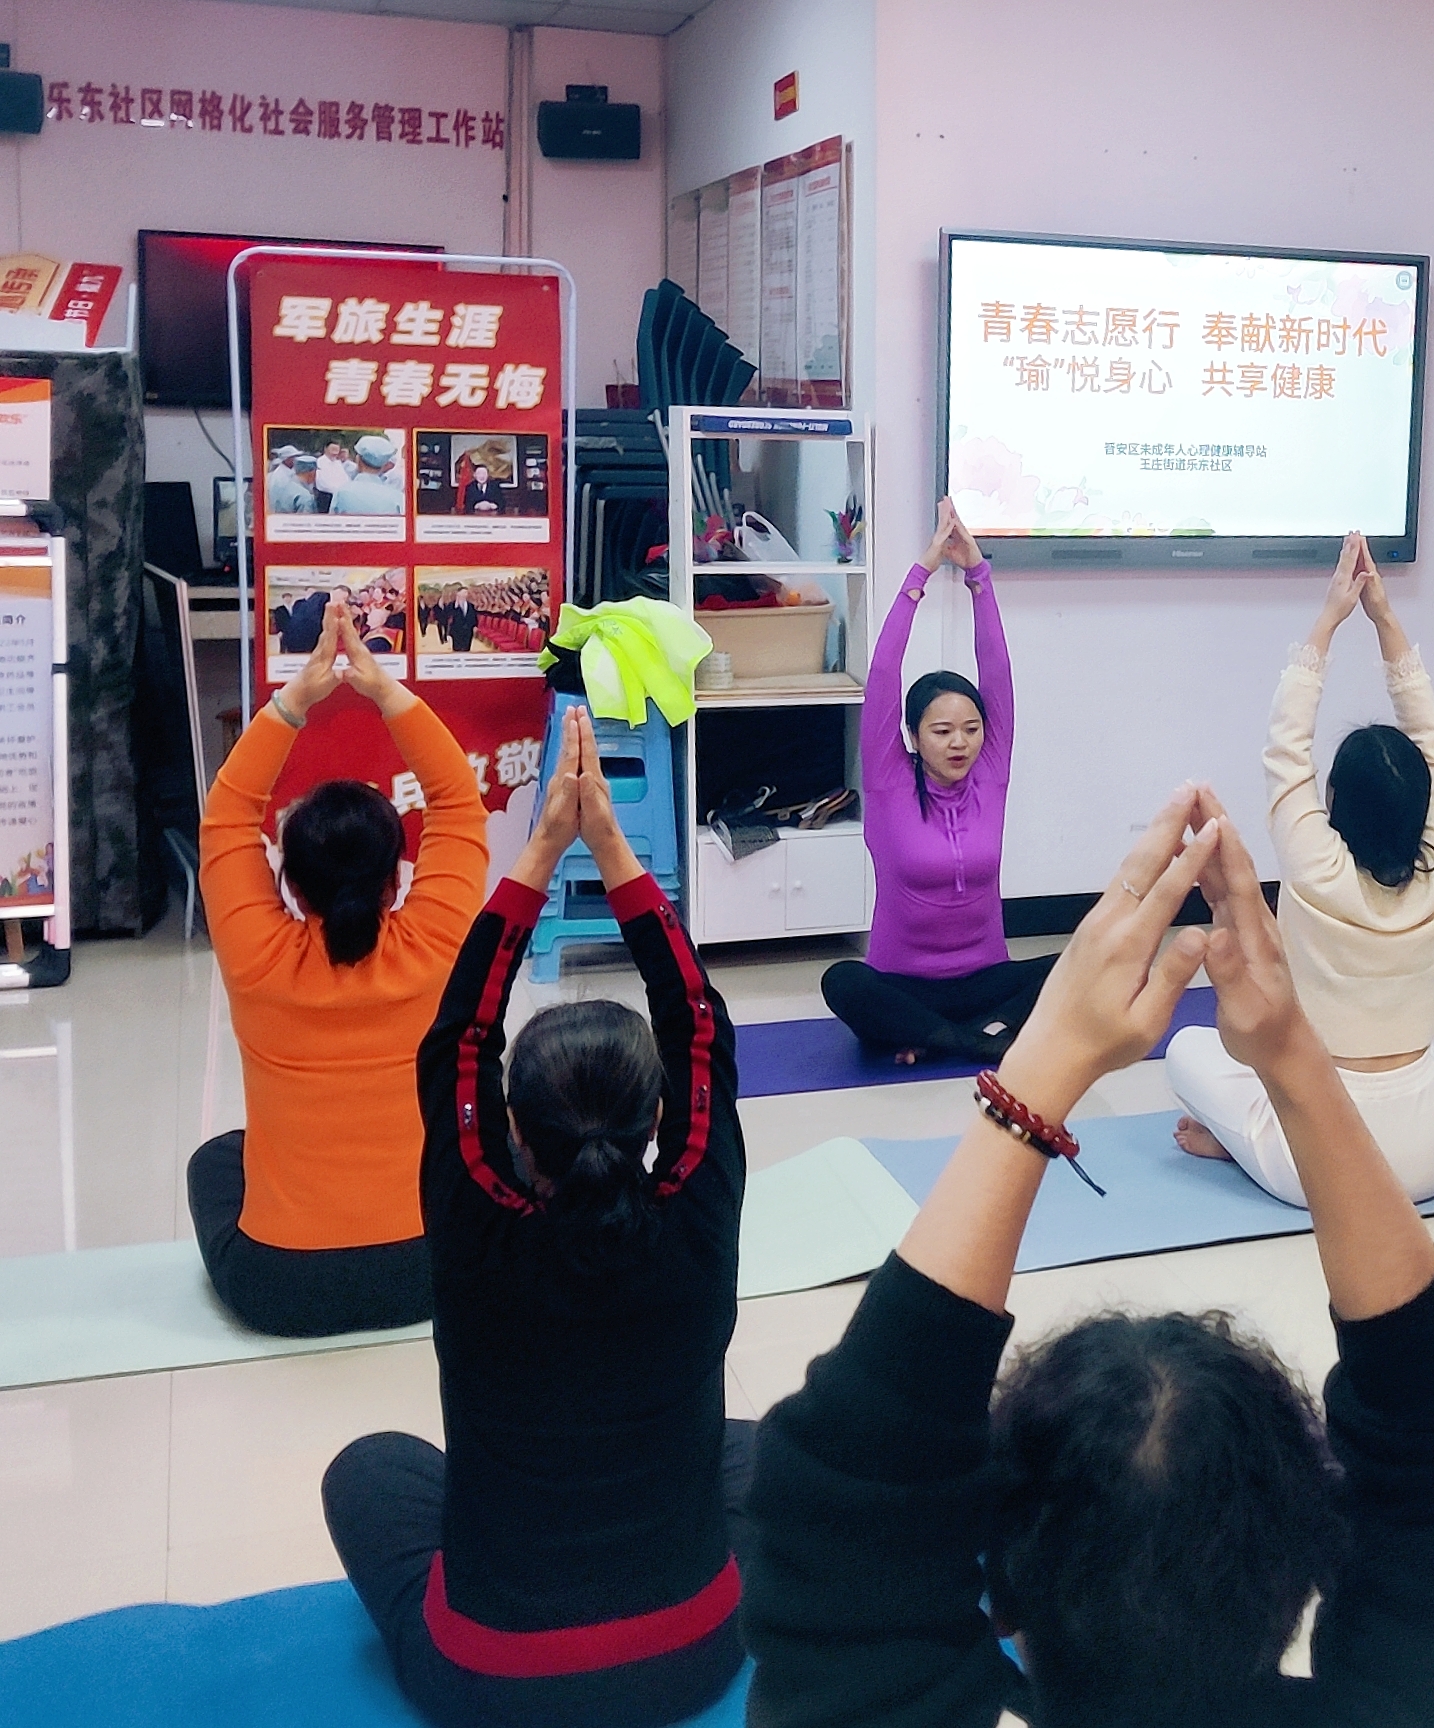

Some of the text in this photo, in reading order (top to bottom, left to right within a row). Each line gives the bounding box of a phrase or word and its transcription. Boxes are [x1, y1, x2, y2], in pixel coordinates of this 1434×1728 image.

[47, 81, 505, 150] 乐东社区网格化社会服务管理工作站
[272, 295, 504, 349] 军旅生涯
[978, 301, 1387, 358] 青春志愿行 奉献新时代
[324, 358, 547, 409] 青春无悔
[1202, 361, 1337, 400] 共享健康
[1104, 442, 1267, 458] 晋安区未成年人心理健康辅导站
[1140, 458, 1232, 472] 王庄街道乐东社区
